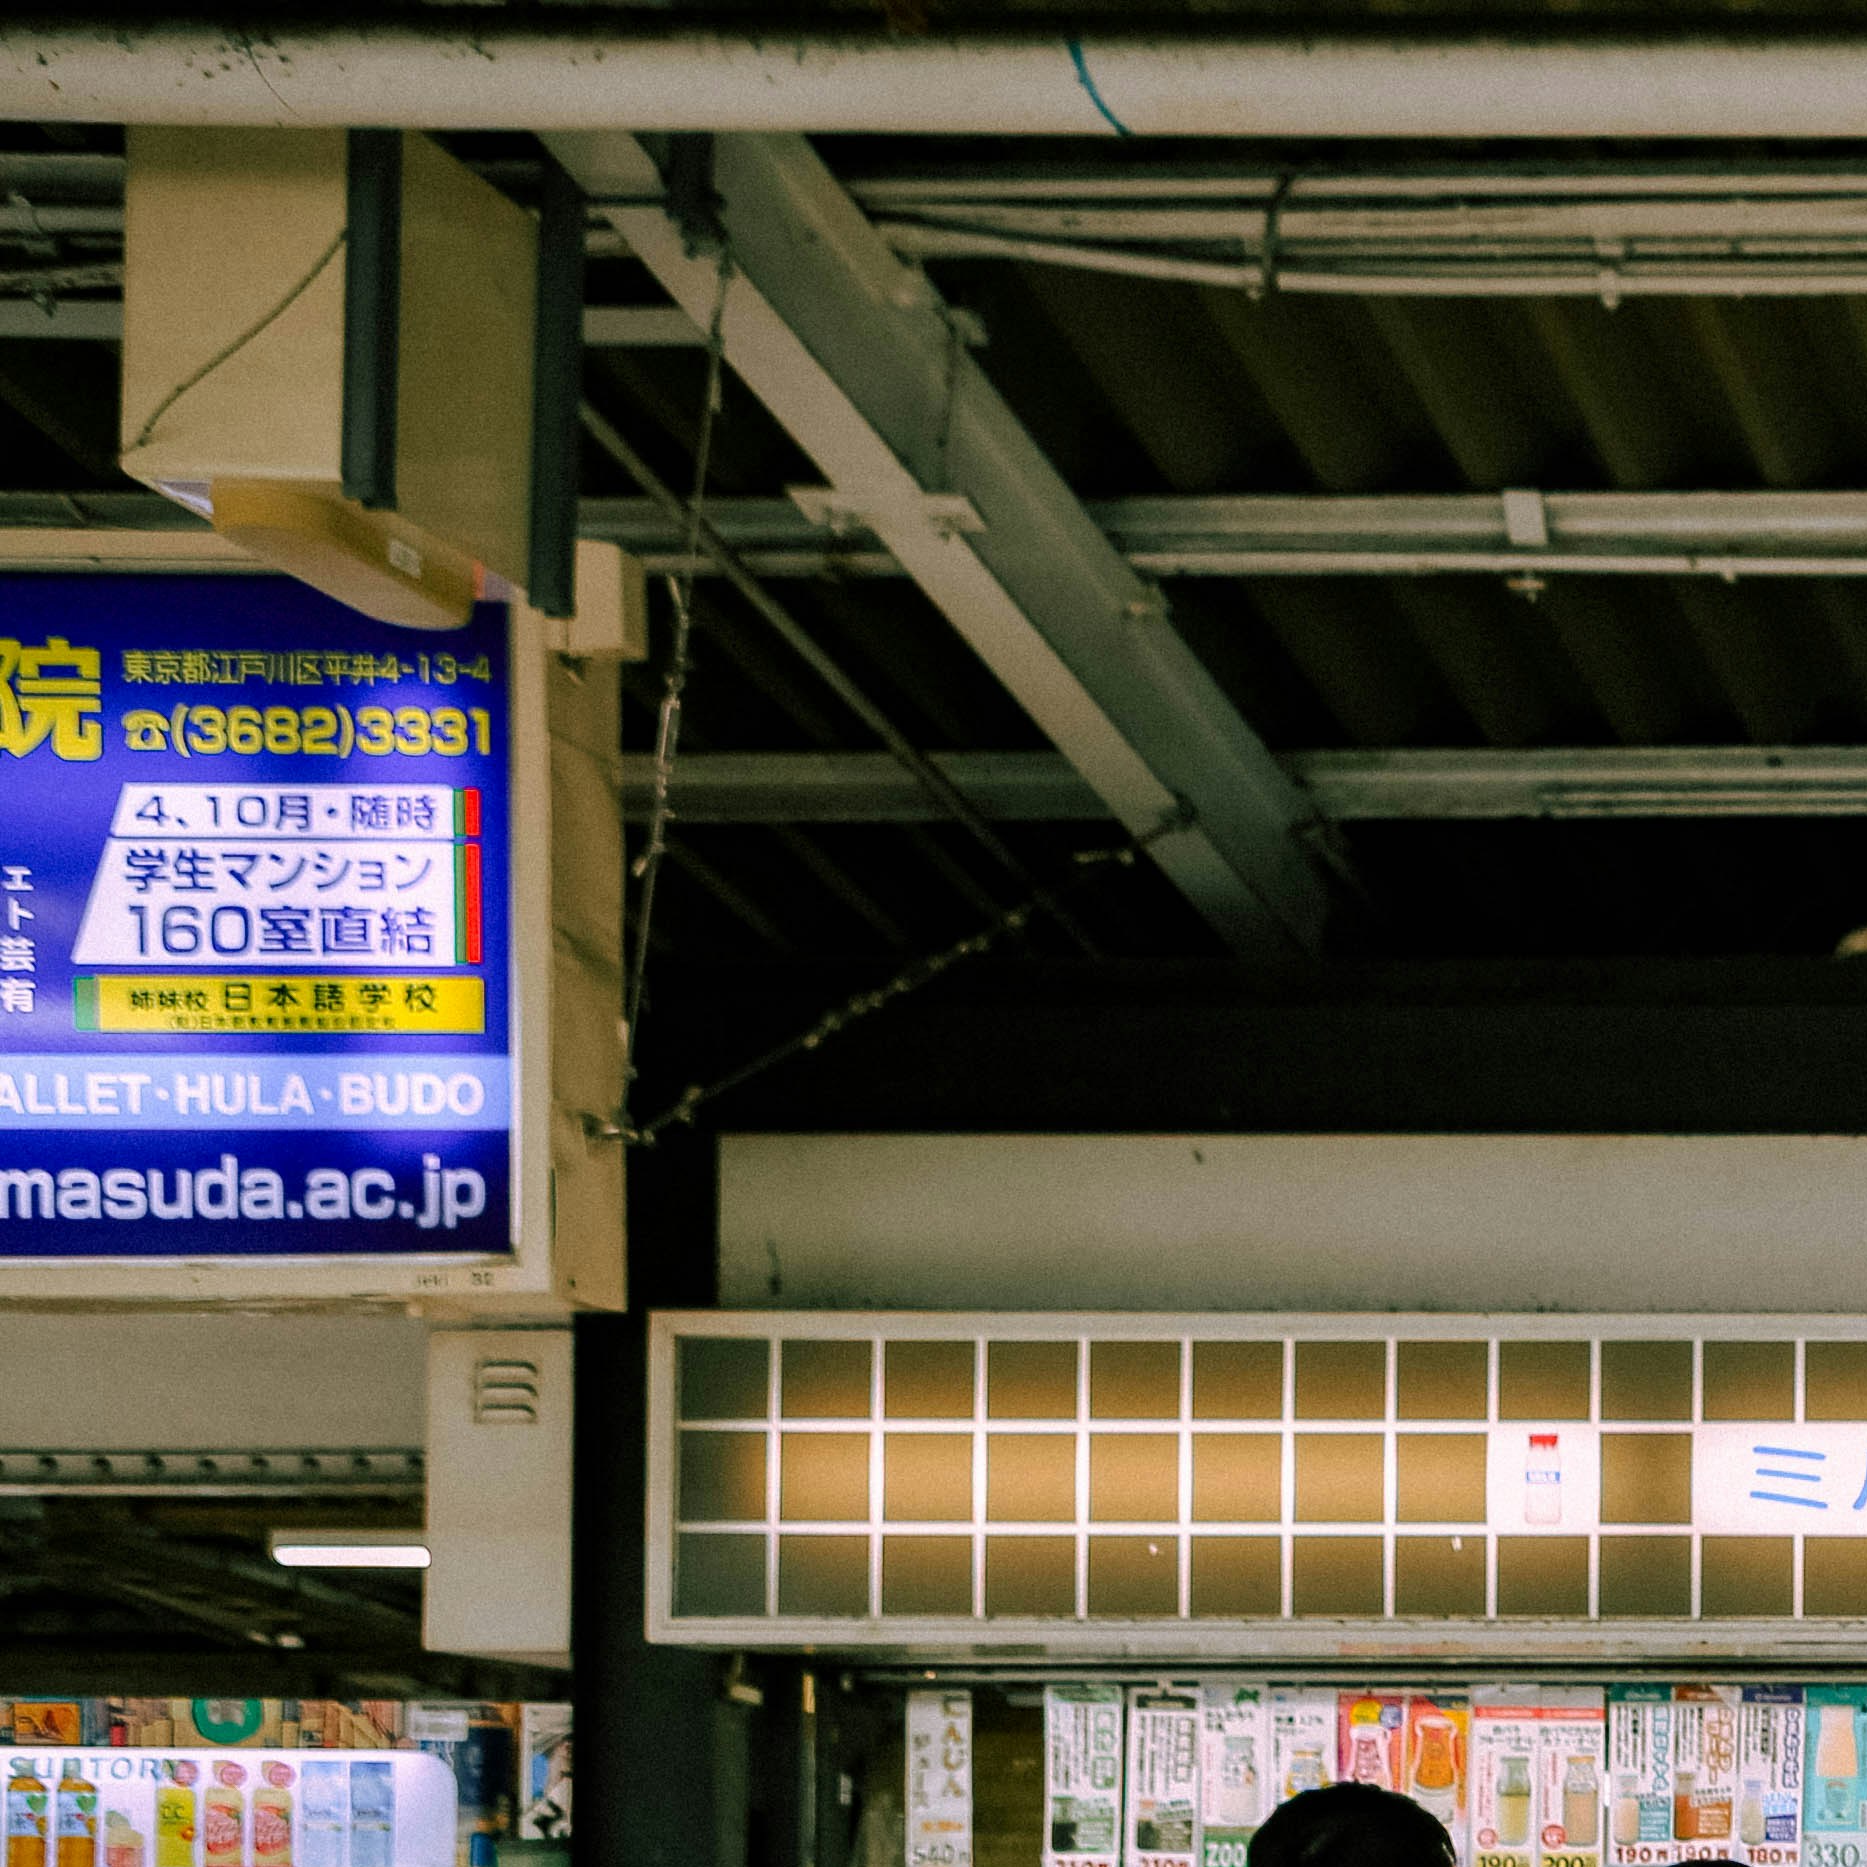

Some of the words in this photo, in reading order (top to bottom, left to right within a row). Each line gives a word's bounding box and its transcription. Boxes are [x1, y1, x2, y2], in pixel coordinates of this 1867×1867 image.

[122, 649, 492, 688] 東京都江戸川区平井4-13-4
[124, 850, 433, 893] 学生マンション
[127, 903, 436, 958] 160室直結
[130, 990, 208, 1013] 姉妹校
[224, 982, 438, 1014] 日本語学校
[0, 1154, 487, 1229] masuda.ac.jp
